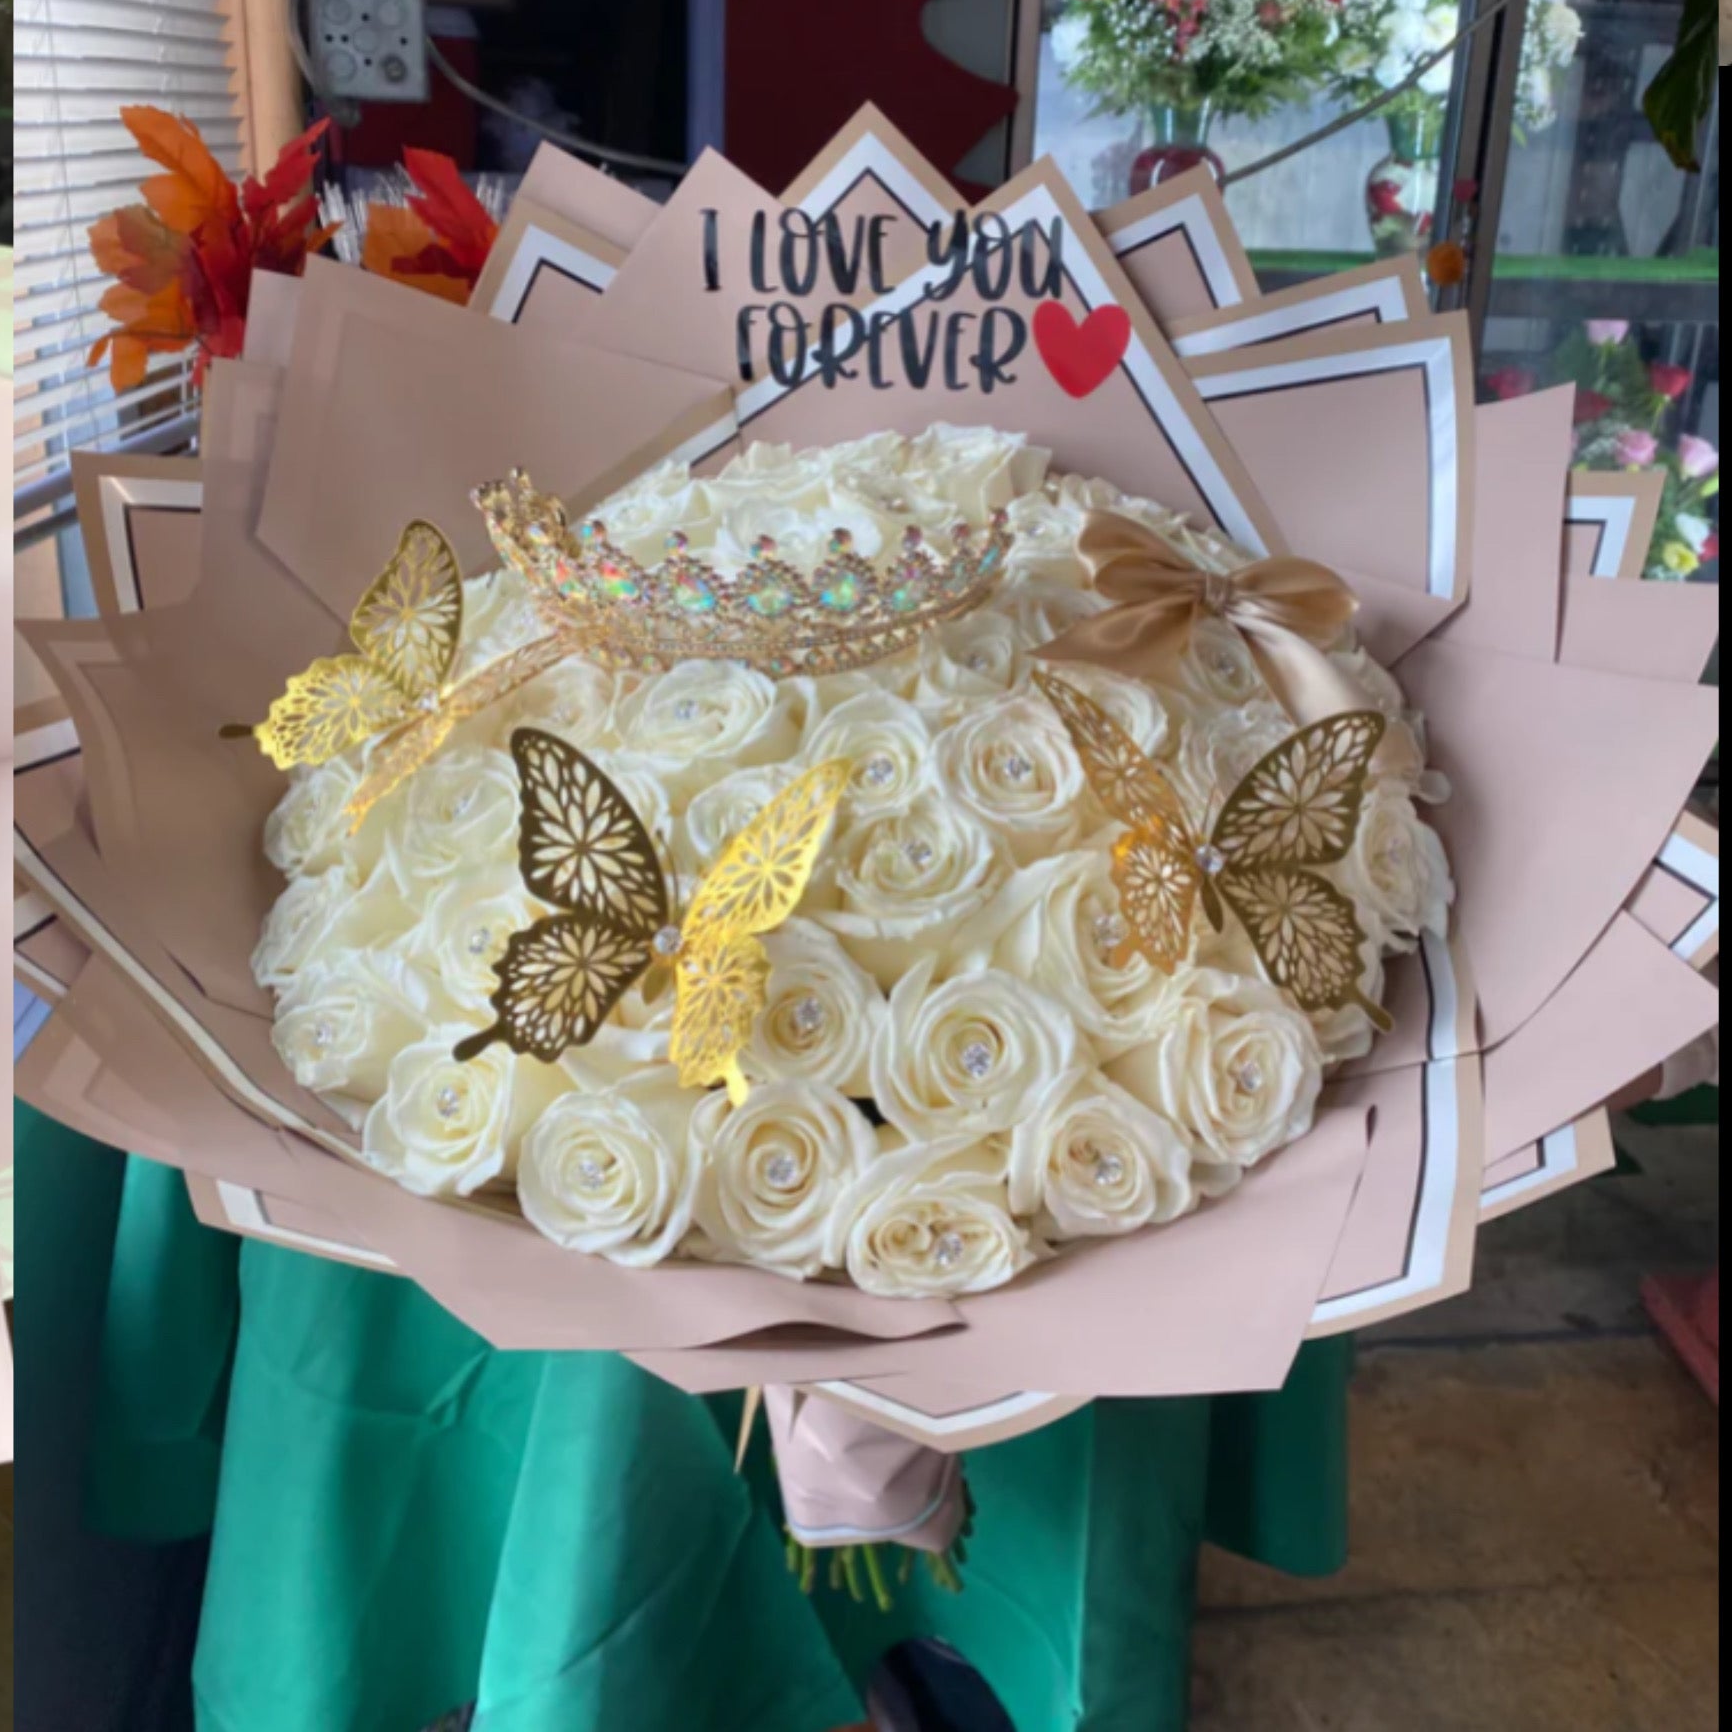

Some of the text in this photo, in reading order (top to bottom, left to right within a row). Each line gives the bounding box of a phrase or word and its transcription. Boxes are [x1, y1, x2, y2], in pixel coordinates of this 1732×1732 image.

[699, 207, 721, 292] I
[749, 206, 898, 297] LOVE
[735, 300, 1028, 395] FOREVER
